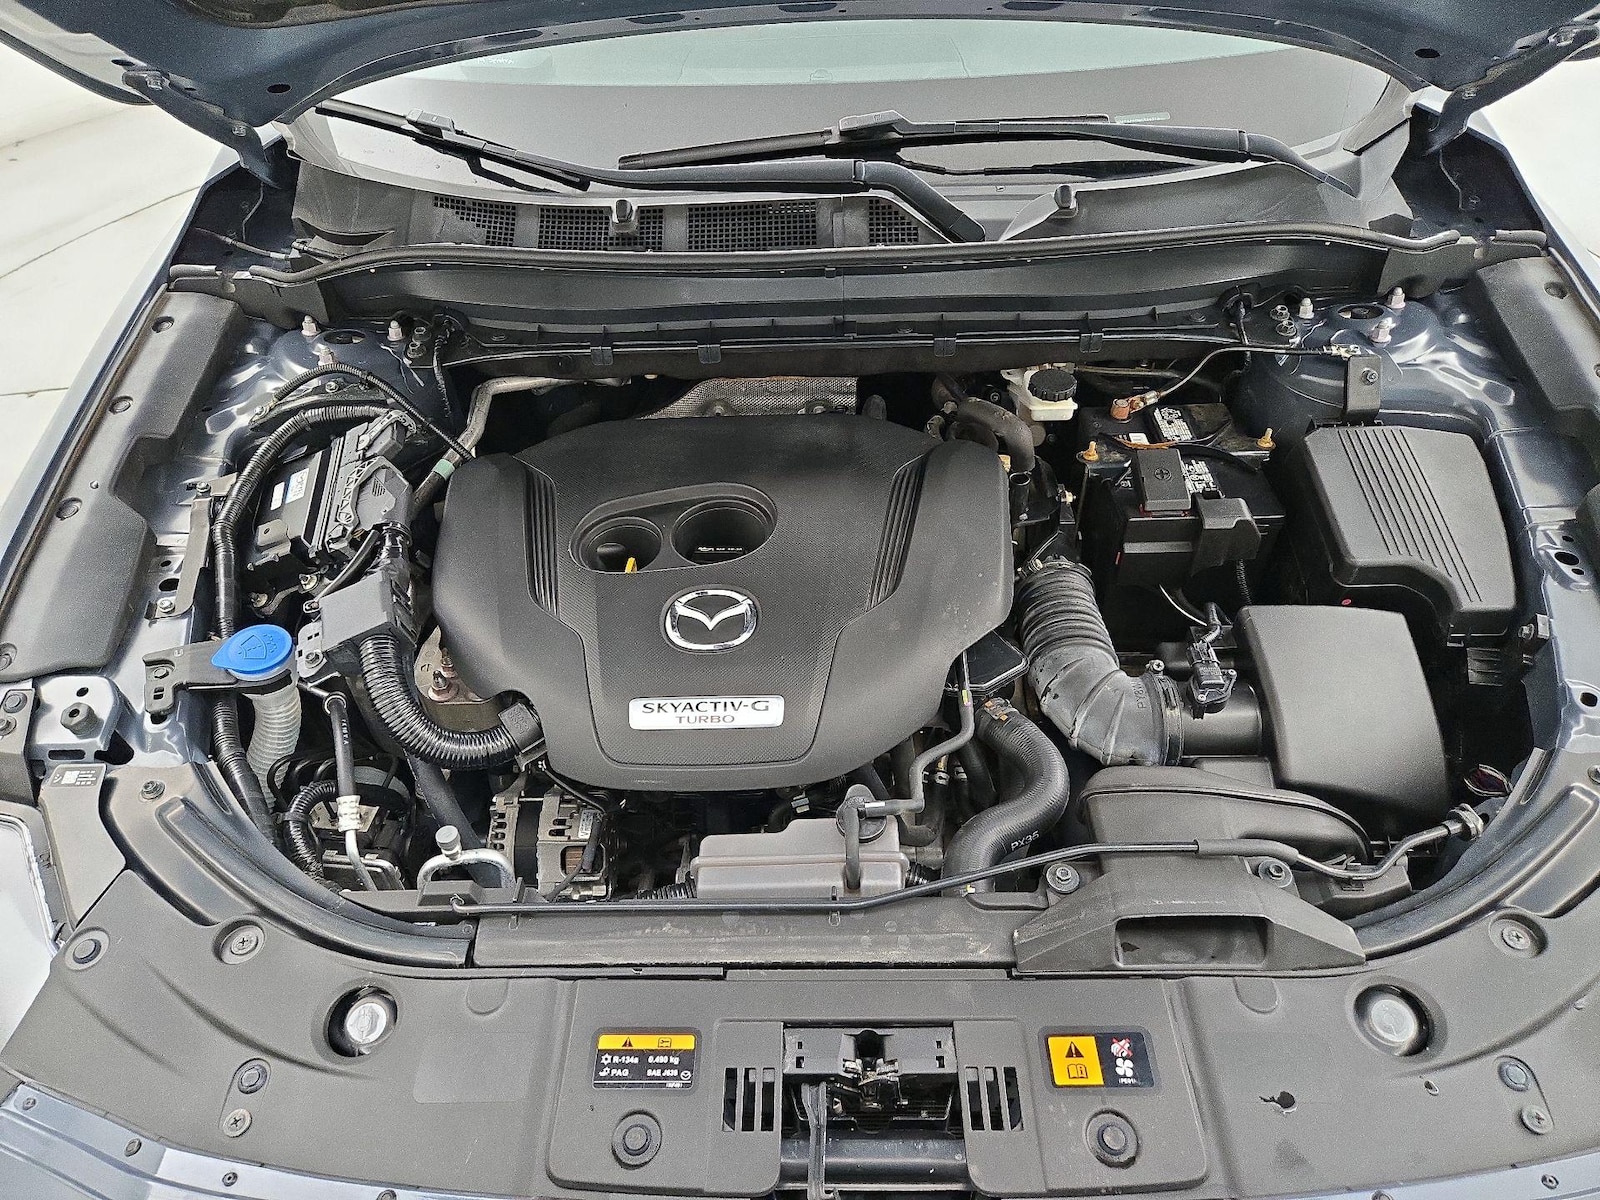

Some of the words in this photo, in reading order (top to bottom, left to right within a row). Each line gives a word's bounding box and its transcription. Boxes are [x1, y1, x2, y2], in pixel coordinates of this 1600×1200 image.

[641, 700, 770, 714] SKYACTIV-G
[675, 714, 735, 724] TURBO
[612, 1055, 640, 1064] R-134a
[669, 1055, 680, 1065] kg
[610, 1068, 630, 1077] PAG
[646, 1068, 662, 1077] SAE
